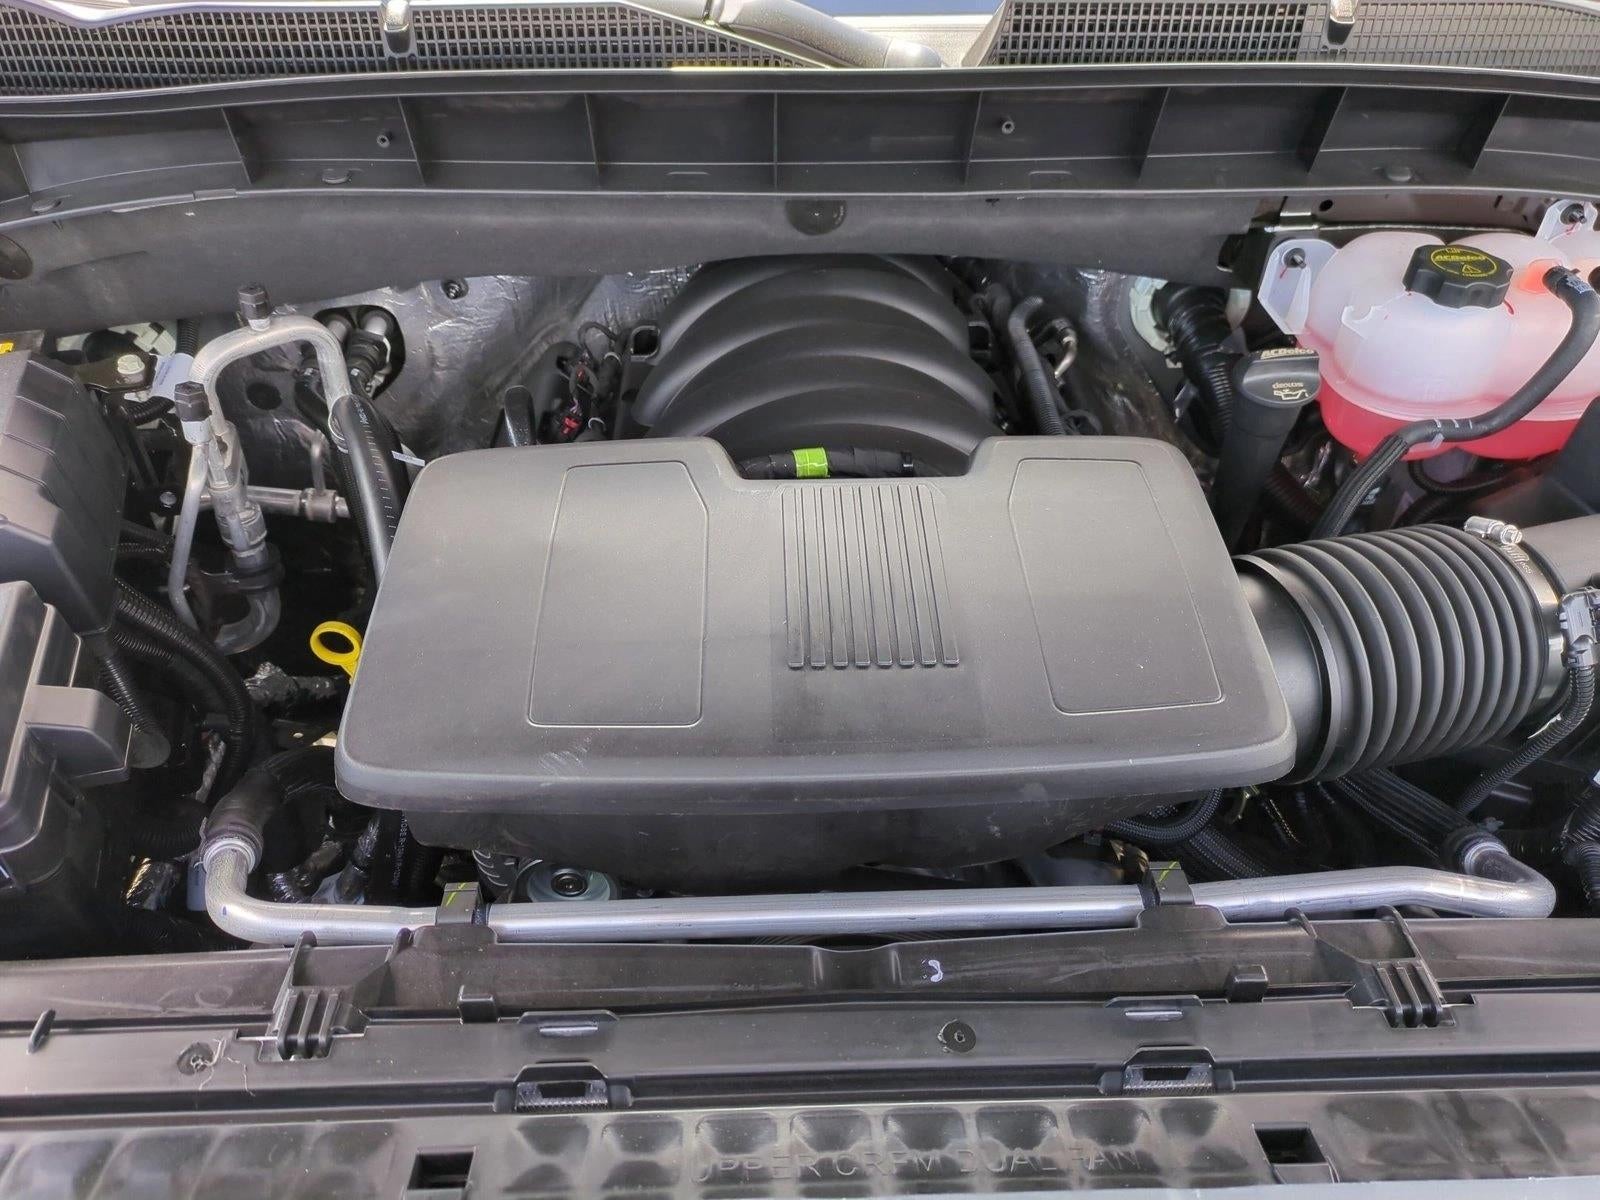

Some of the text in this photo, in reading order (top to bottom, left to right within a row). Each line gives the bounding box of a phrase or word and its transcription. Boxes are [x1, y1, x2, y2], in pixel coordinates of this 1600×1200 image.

[1260, 348, 1315, 360] ACDelco
[689, 1154, 822, 1182] UPPER
[957, 1148, 1057, 1173] DUAL
[1068, 1145, 1141, 1170] FAN
